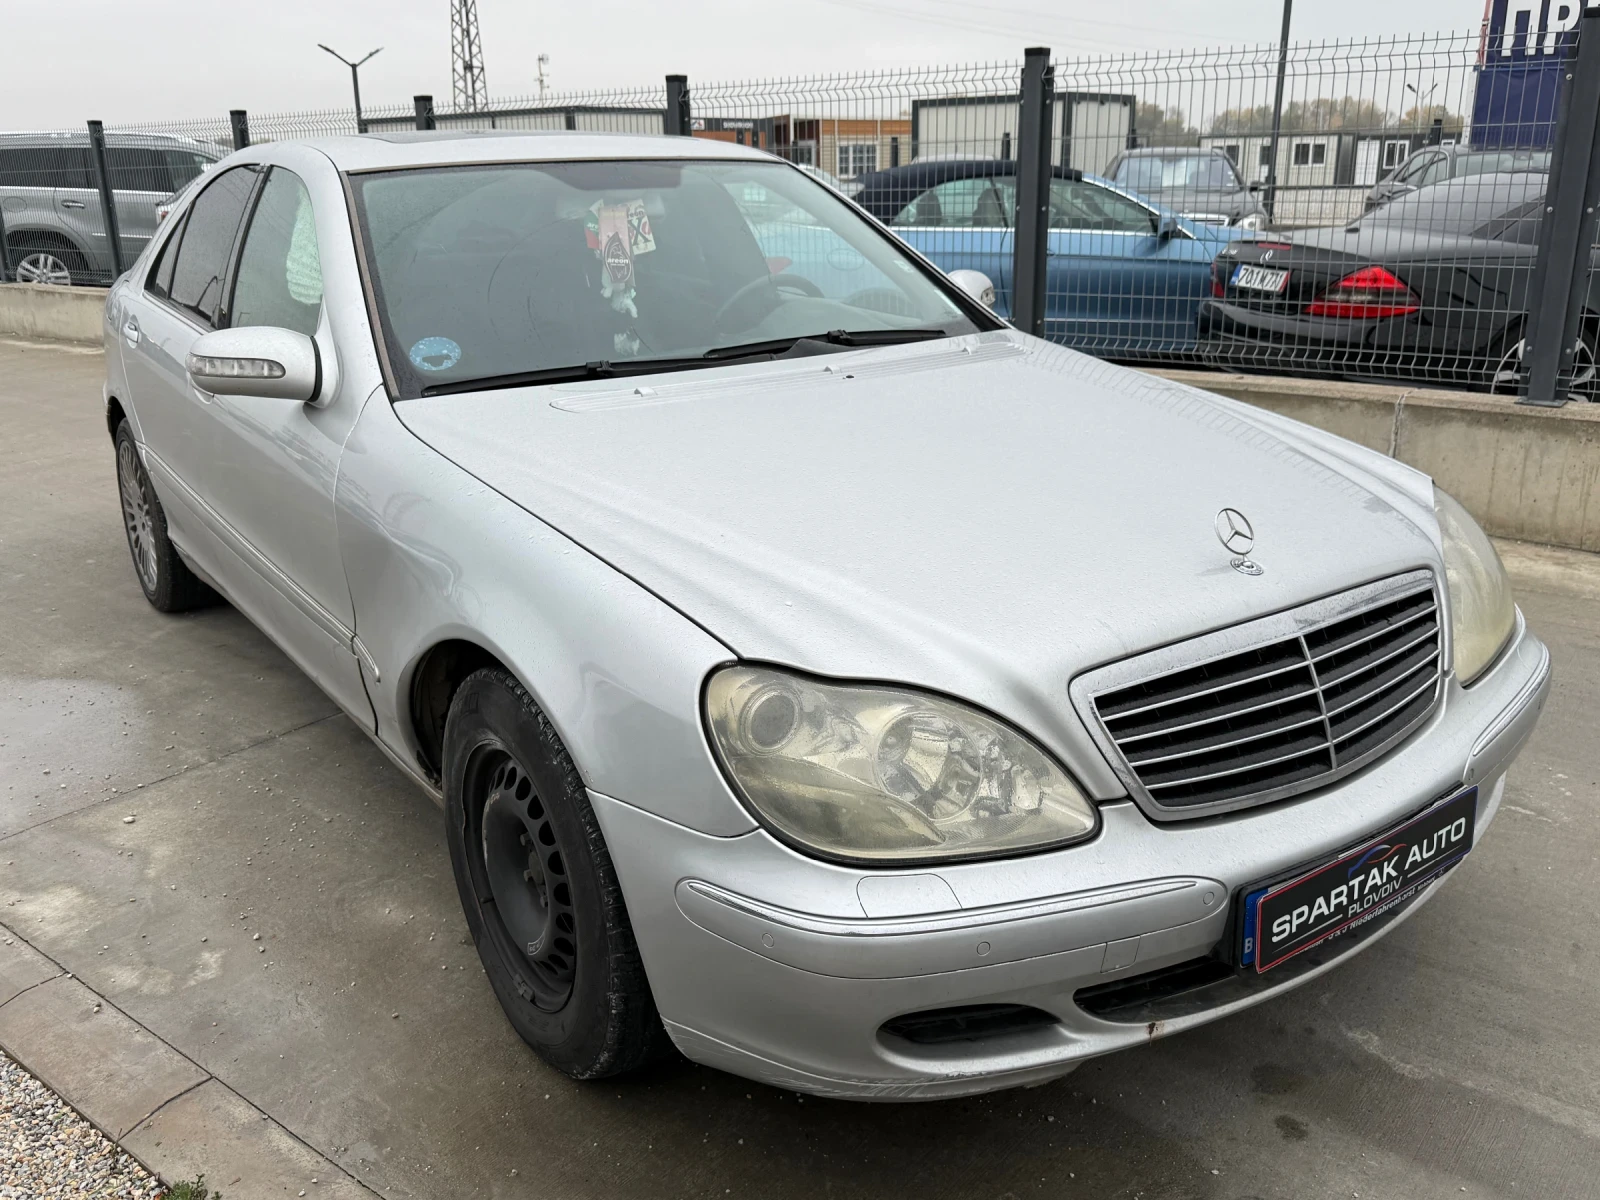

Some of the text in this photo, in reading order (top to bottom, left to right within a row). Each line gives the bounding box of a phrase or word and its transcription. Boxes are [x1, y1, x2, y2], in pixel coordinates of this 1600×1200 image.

[1501, 0, 1600, 57] ПР
[1271, 816, 1466, 943] SPARTAK AUTO
[1347, 876, 1403, 918] PLOVDIV
